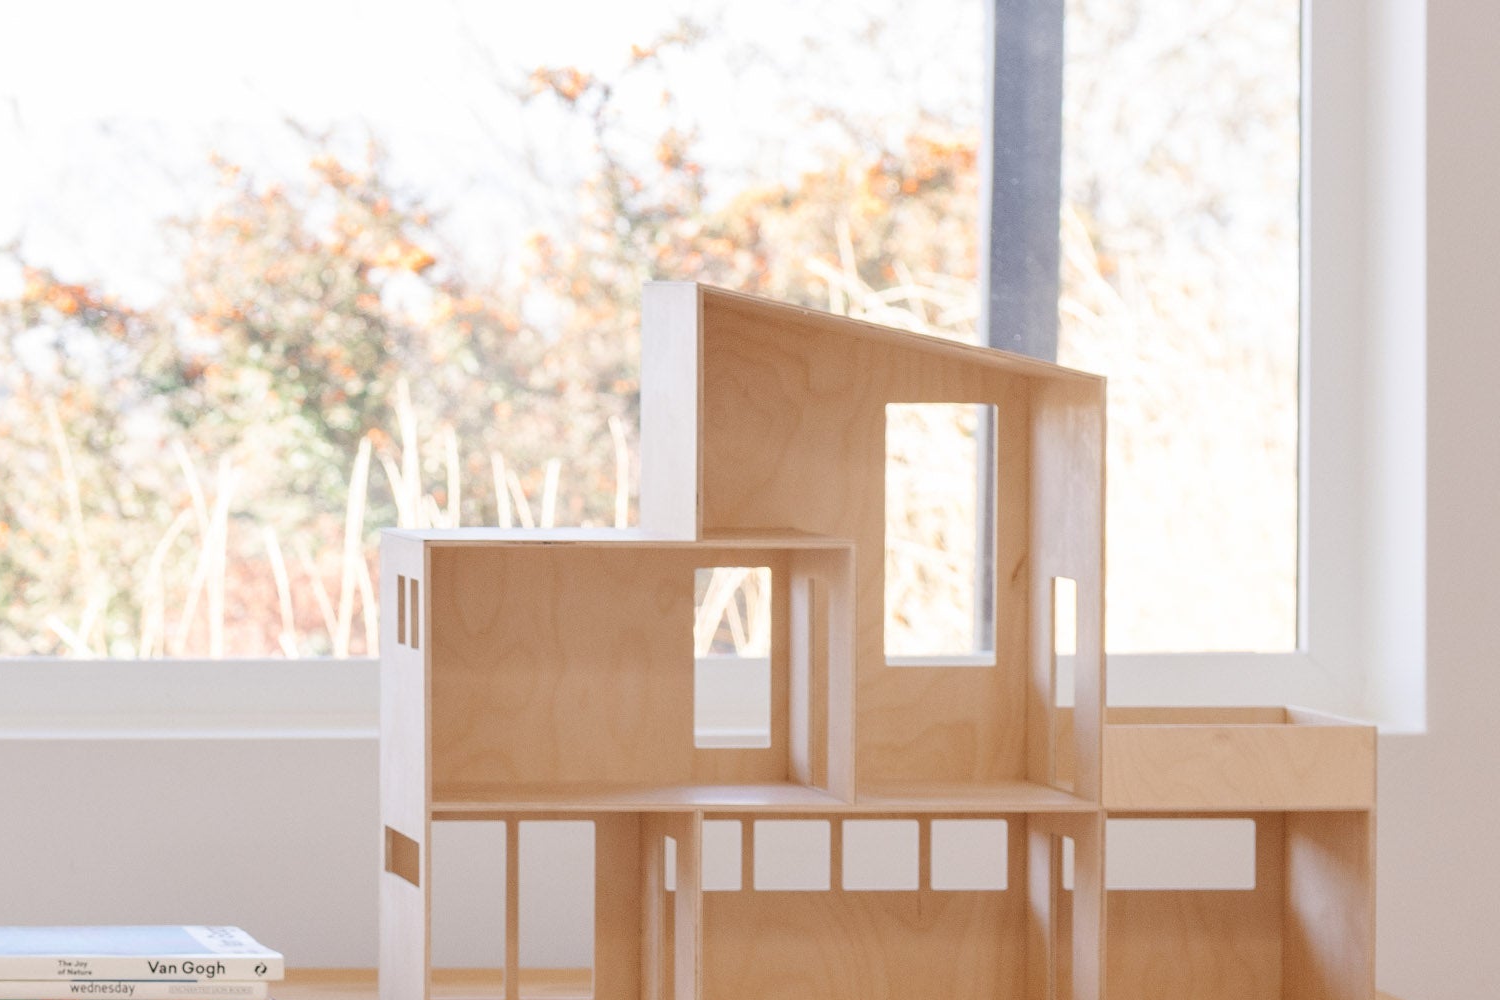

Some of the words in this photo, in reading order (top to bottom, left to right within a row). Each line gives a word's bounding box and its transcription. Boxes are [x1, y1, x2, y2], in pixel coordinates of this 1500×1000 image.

[75, 960, 88, 969] Joy
[148, 961, 177, 974] Van
[182, 961, 226, 978] Gogh
[70, 981, 136, 996] wednesday
